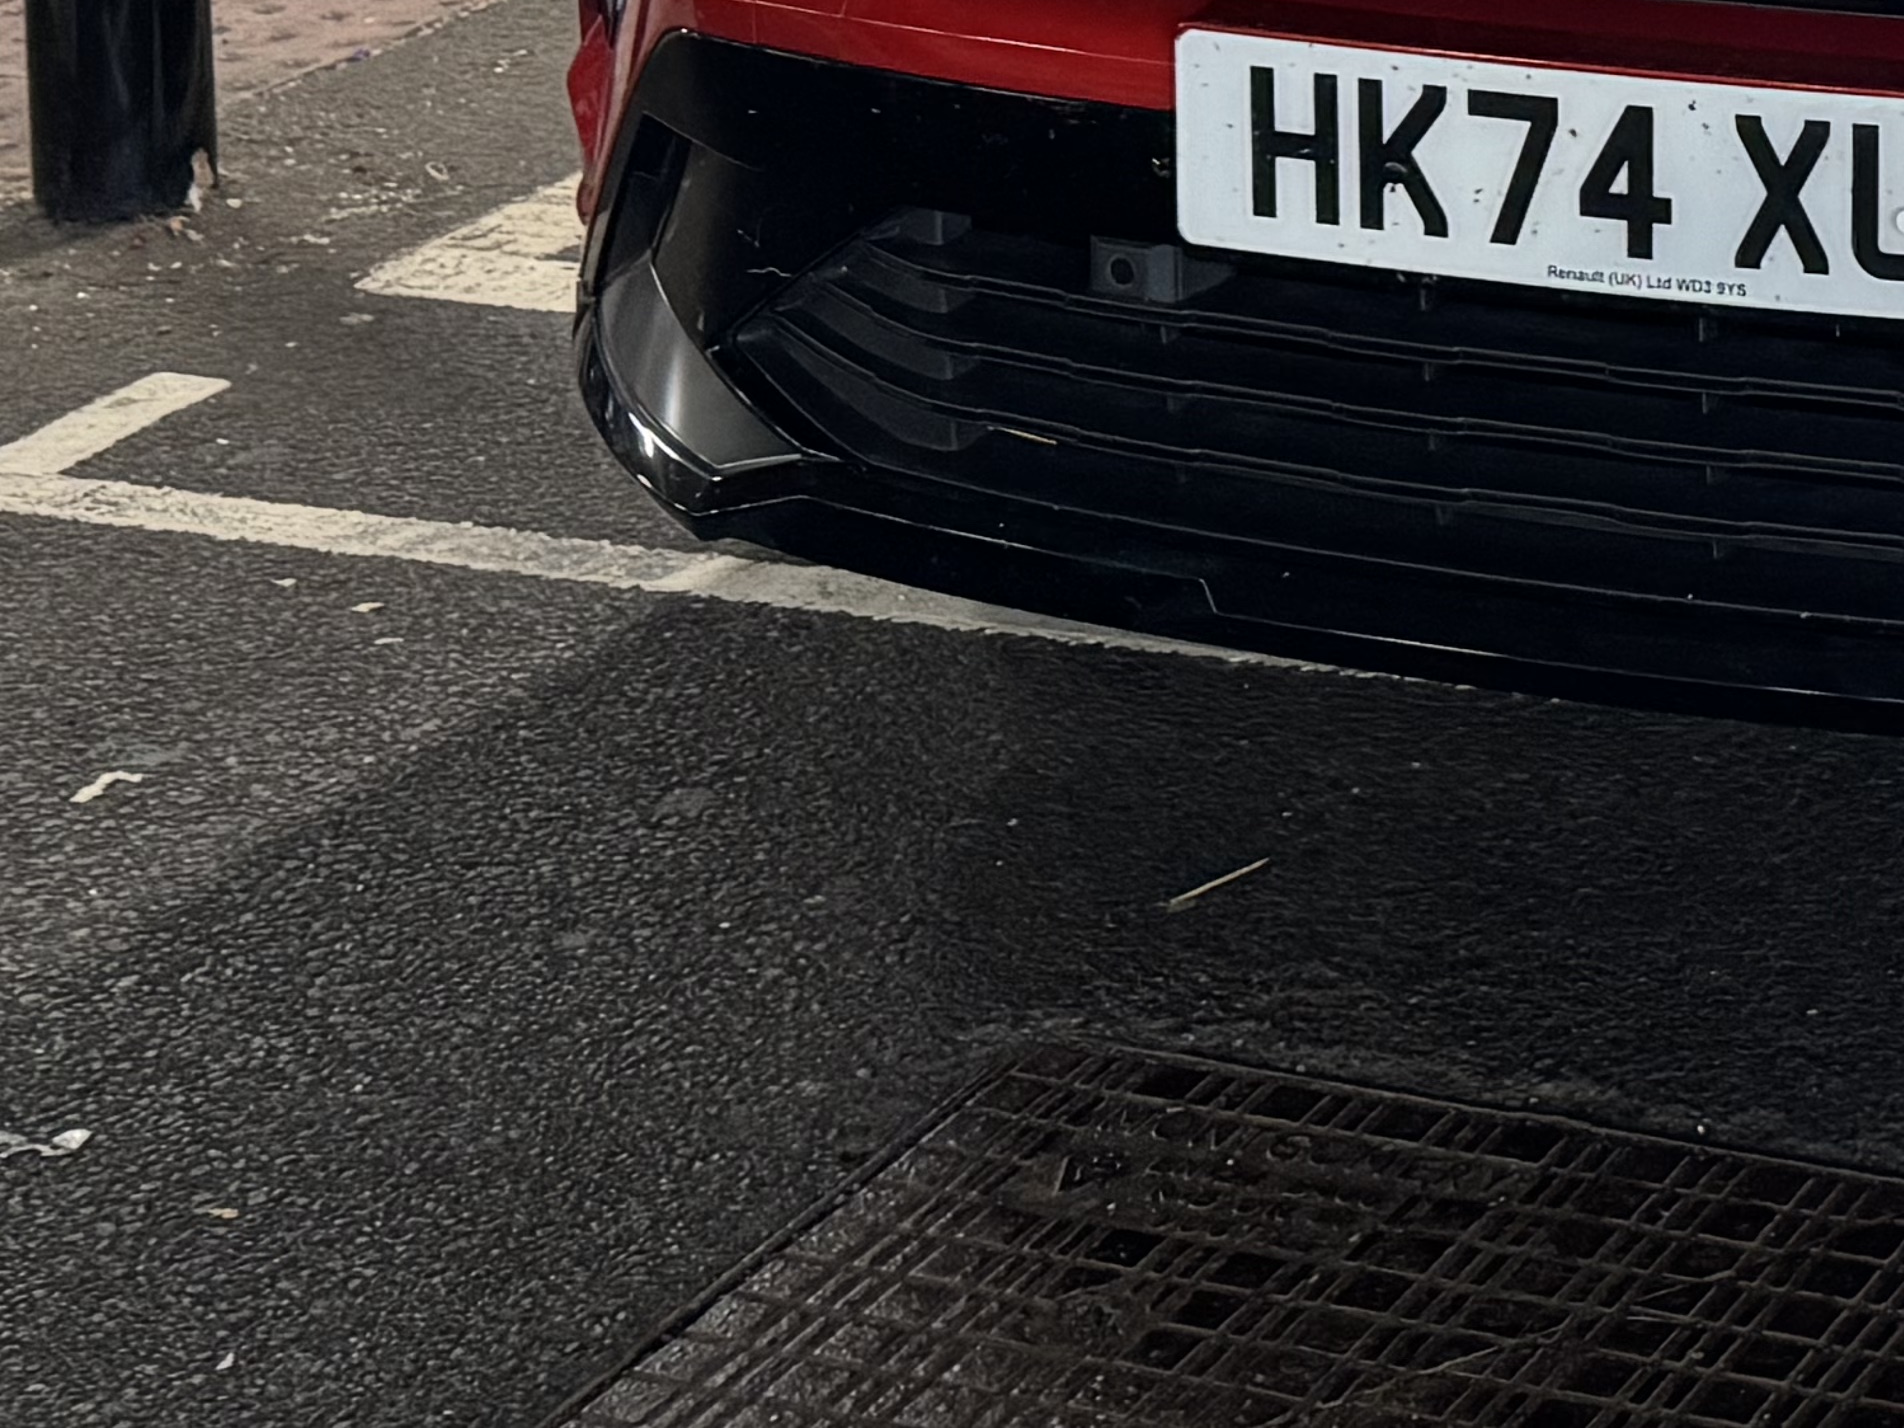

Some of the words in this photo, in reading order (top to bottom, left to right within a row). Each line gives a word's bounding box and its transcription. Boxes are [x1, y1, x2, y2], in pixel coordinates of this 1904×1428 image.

[1248, 65, 1673, 261] HK74
[1547, 265, 1605, 284] Renault
[1609, 271, 1642, 290] (UK)
[1647, 275, 1671, 290] Ltd
